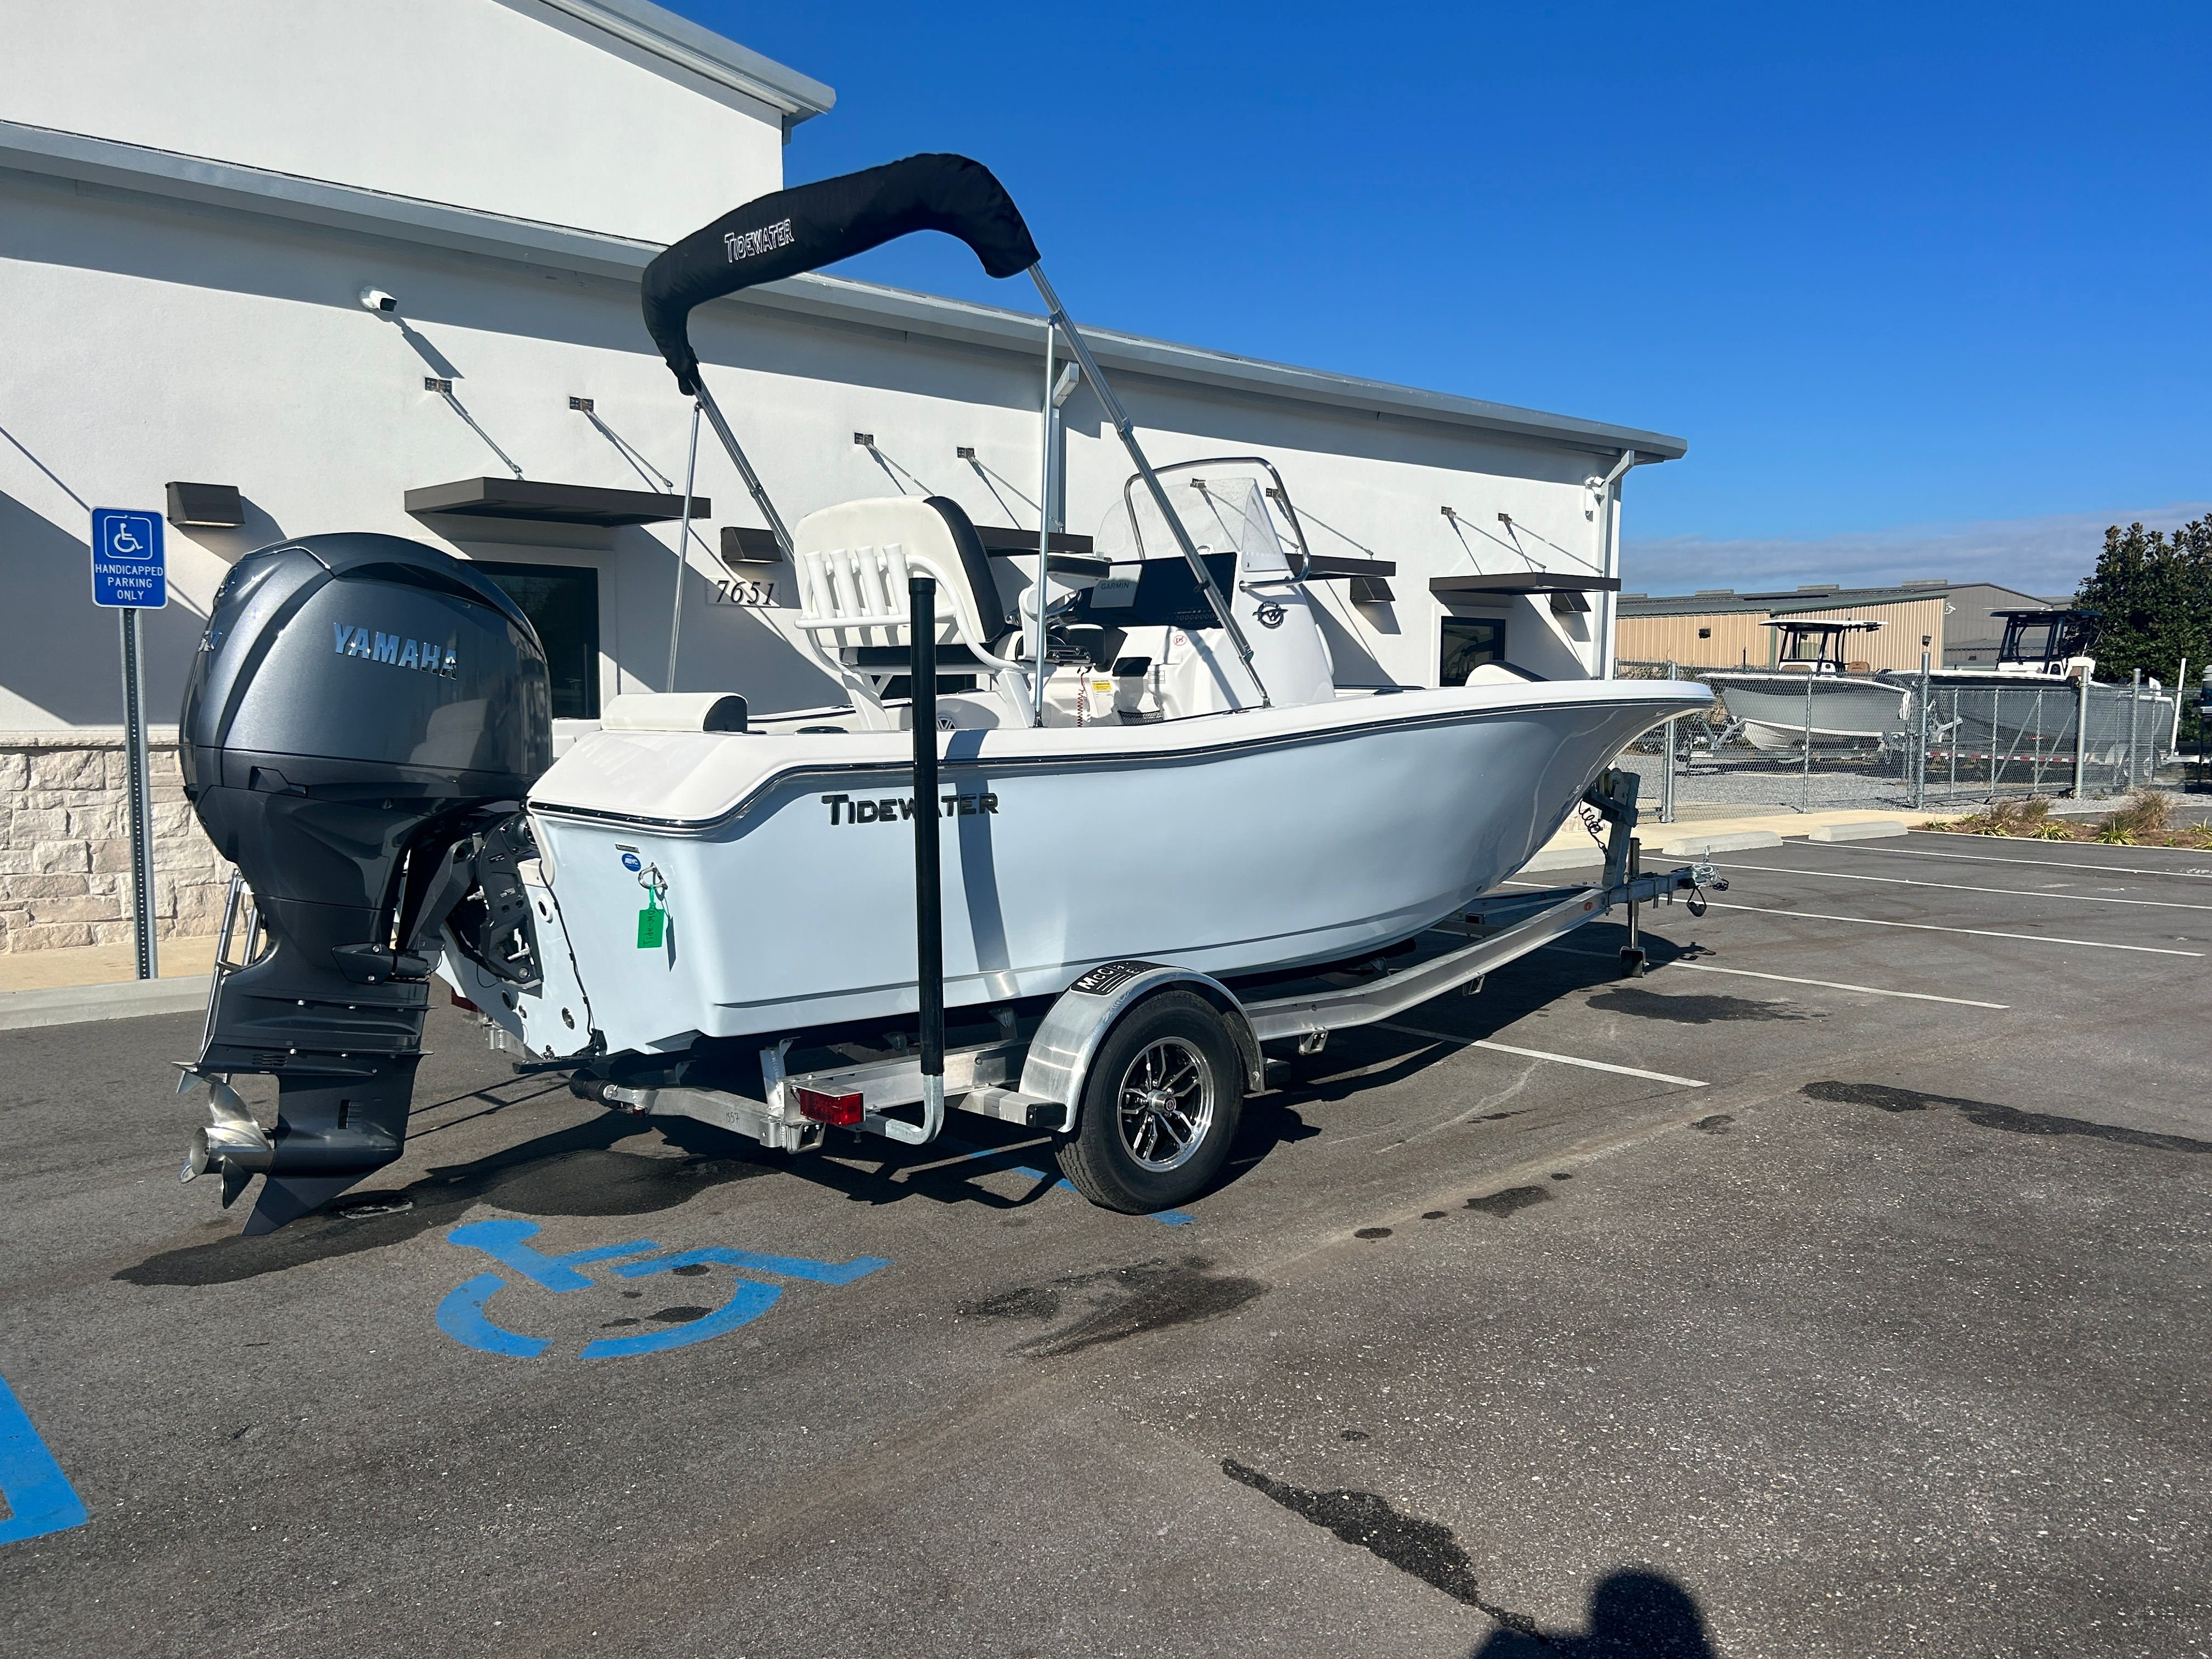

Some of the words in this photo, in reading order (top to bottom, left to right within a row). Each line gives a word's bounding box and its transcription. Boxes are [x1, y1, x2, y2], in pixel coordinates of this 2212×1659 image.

[95, 563, 163, 577] HANDICAPPED
[108, 577, 153, 588] PARKING
[1101, 582, 1130, 590] GARMIN
[117, 590, 144, 600] ONLY
[716, 580, 775, 606] 7651
[334, 622, 457, 680] YAMAHA
[821, 793, 999, 826] TIDEWTER
